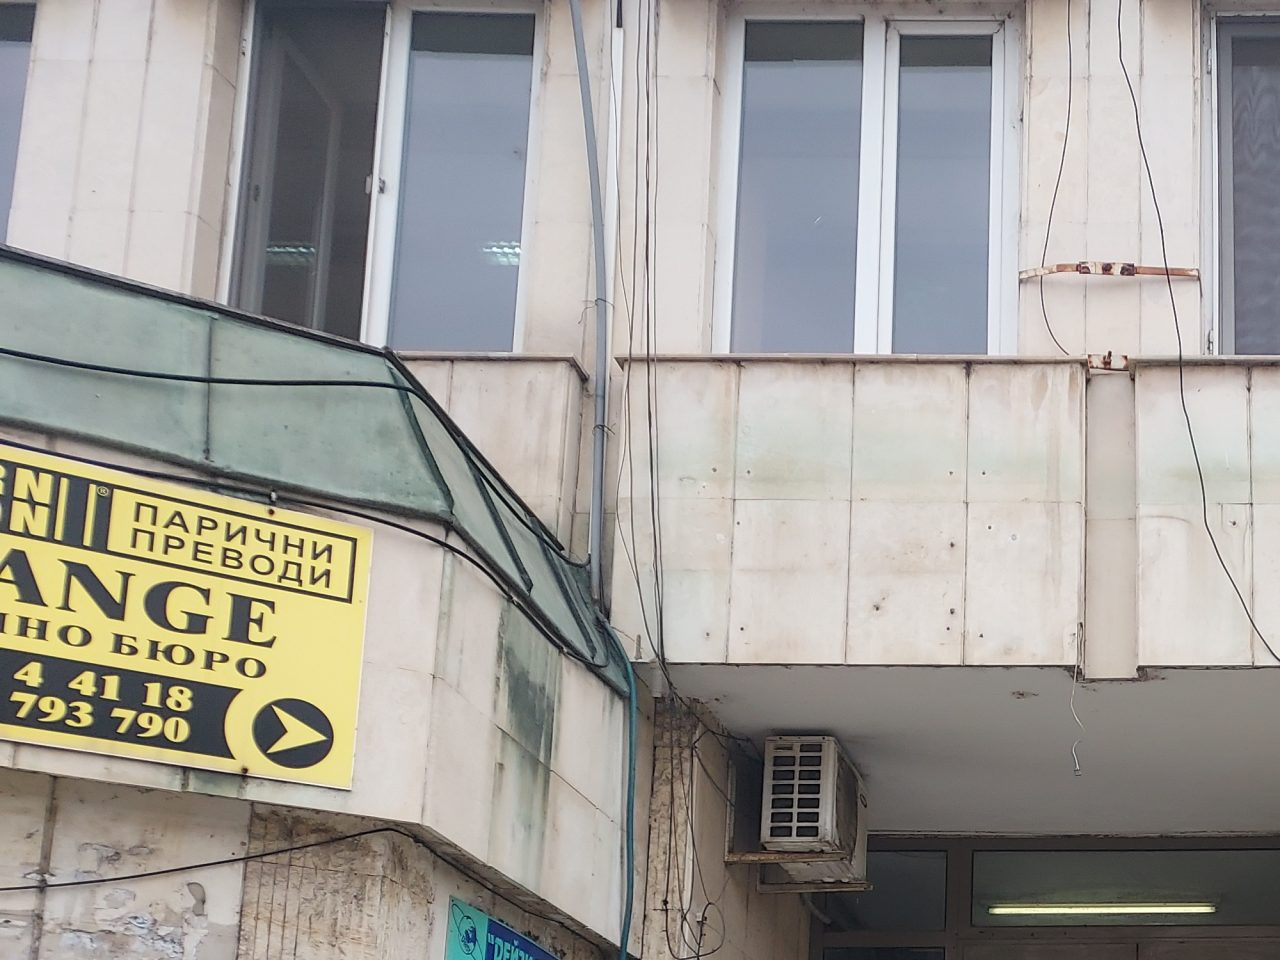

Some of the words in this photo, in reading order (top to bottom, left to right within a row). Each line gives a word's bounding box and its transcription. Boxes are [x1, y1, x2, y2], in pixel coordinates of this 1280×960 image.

[133, 501, 334, 564] ПАРИЧНИ
[130, 529, 331, 590] ПРЕВОДИ
[110, 633, 267, 679] БЮРО
[13, 661, 44, 687] 4
[68, 671, 121, 700] 41
[143, 682, 193, 712] 18
[10, 691, 95, 728] 793
[110, 708, 191, 743] 790
